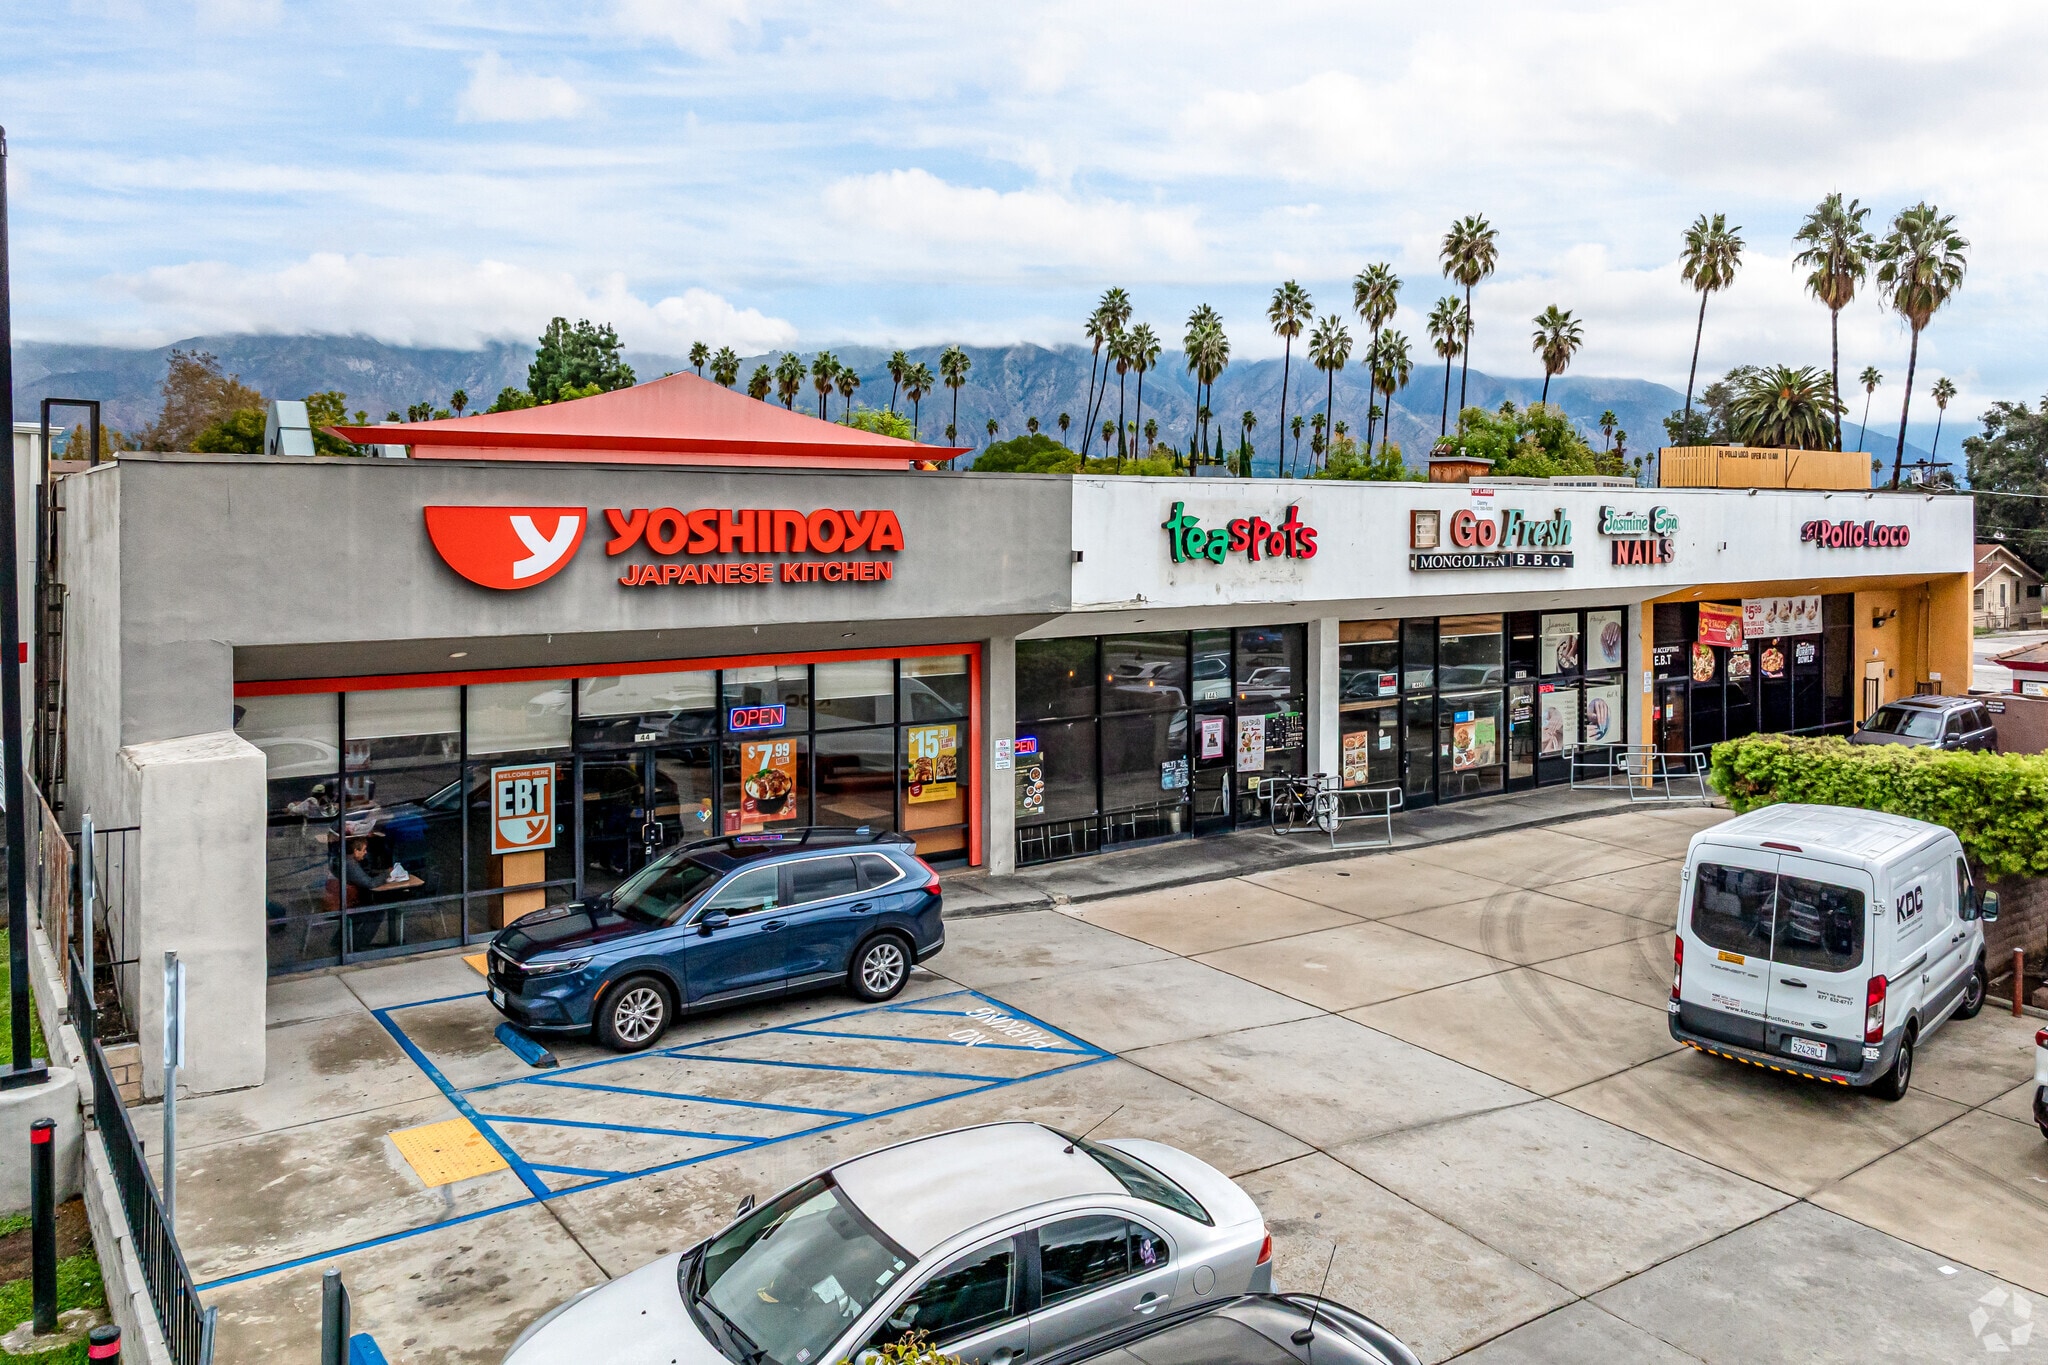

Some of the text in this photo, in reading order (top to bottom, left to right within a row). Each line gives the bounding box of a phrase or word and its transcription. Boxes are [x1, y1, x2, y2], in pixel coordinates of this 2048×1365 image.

[605, 508, 904, 555] YOSHINOYA
[1451, 507, 1573, 548] Go Fresh
[1602, 507, 1679, 536] Jasmine Spa
[1803, 519, 1910, 548] El Pollo Loco
[1420, 553, 1505, 569] MONGOLIAN
[1612, 539, 1675, 565] NAILS
[619, 561, 893, 586] JAPANESE KITCHEN
[732, 708, 783, 727] OPEN
[1014, 741, 1035, 752] PEN
[498, 770, 531, 779] WELCOME
[498, 777, 549, 818] EBT
[1896, 885, 1923, 925] KDC
[966, 1007, 1061, 1050] PARKING
